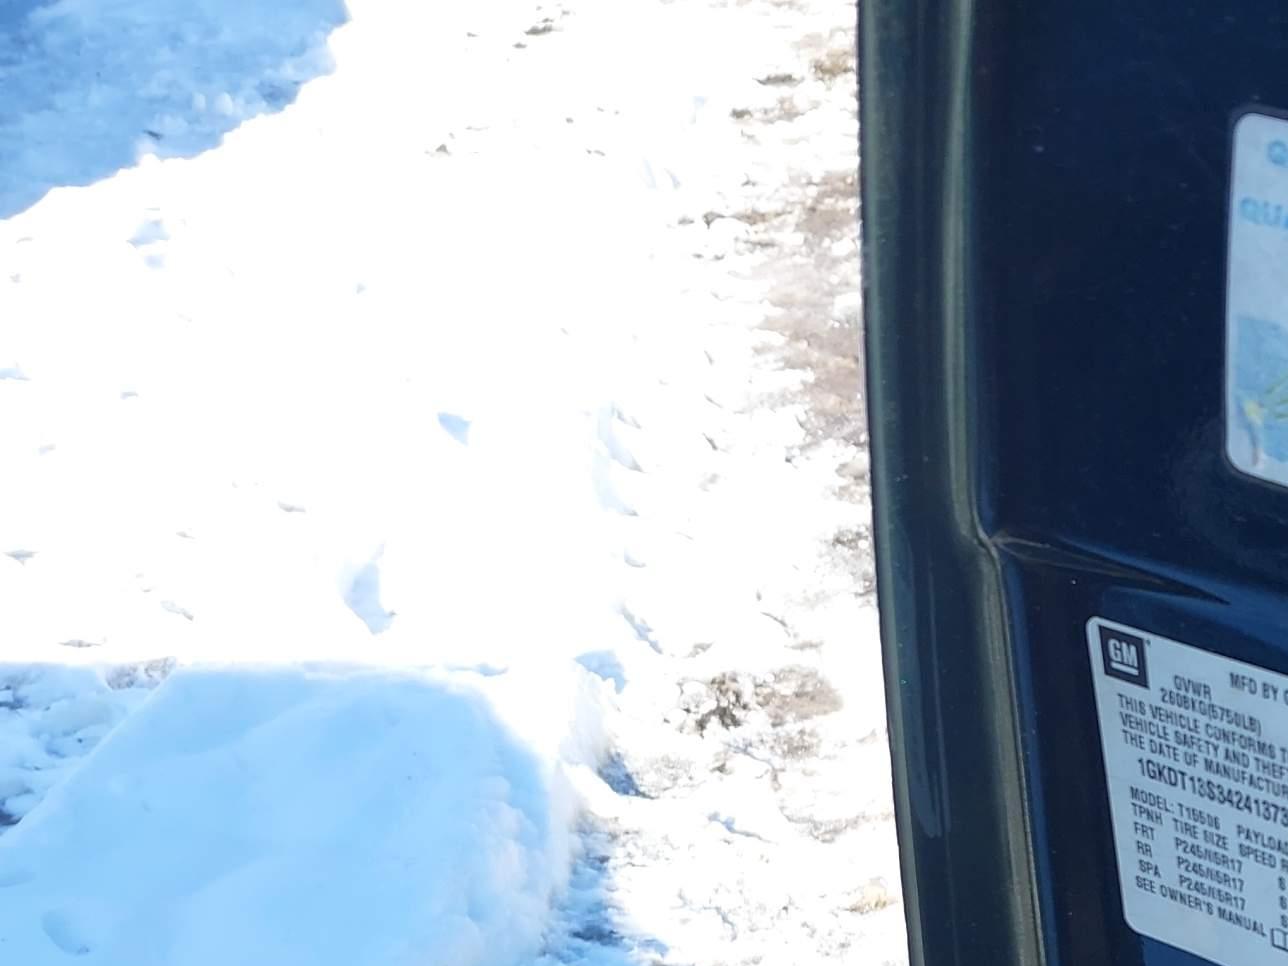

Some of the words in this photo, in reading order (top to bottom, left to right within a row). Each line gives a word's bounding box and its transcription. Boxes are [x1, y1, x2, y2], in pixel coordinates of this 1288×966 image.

[1107, 638, 1139, 668] GM
[1173, 674, 1211, 701] GVWR
[1229, 671, 1257, 694] MFD
[1261, 682, 1278, 700] BY
[1117, 692, 1146, 715] THIS
[1148, 703, 1199, 734] VEHICLE
[1204, 722, 1275, 759] CONFORMS
[1159, 687, 1261, 736] 2608KG(5750LB)
[1119, 711, 1169, 741] VEHICLE
[1173, 730, 1219, 757] SAFETY
[1224, 747, 1249, 768] AND
[1121, 728, 1145, 749] THE
[1148, 738, 1179, 761] DATE
[1183, 751, 1198, 767] OF
[1129, 785, 1173, 813] MODEL:
[1130, 802, 1162, 824] TPNH
[1133, 821, 1154, 840] FRT
[1172, 817, 1198, 839] TIRE
[1202, 829, 1228, 850] SIZE
[1136, 839, 1152, 857] RR
[1238, 842, 1276, 868] SPEED
[1138, 859, 1160, 878] SPA
[1135, 875, 1155, 893] SEE
[1159, 884, 1213, 915] OWNER'S
[1217, 906, 1266, 937] MANUAL
